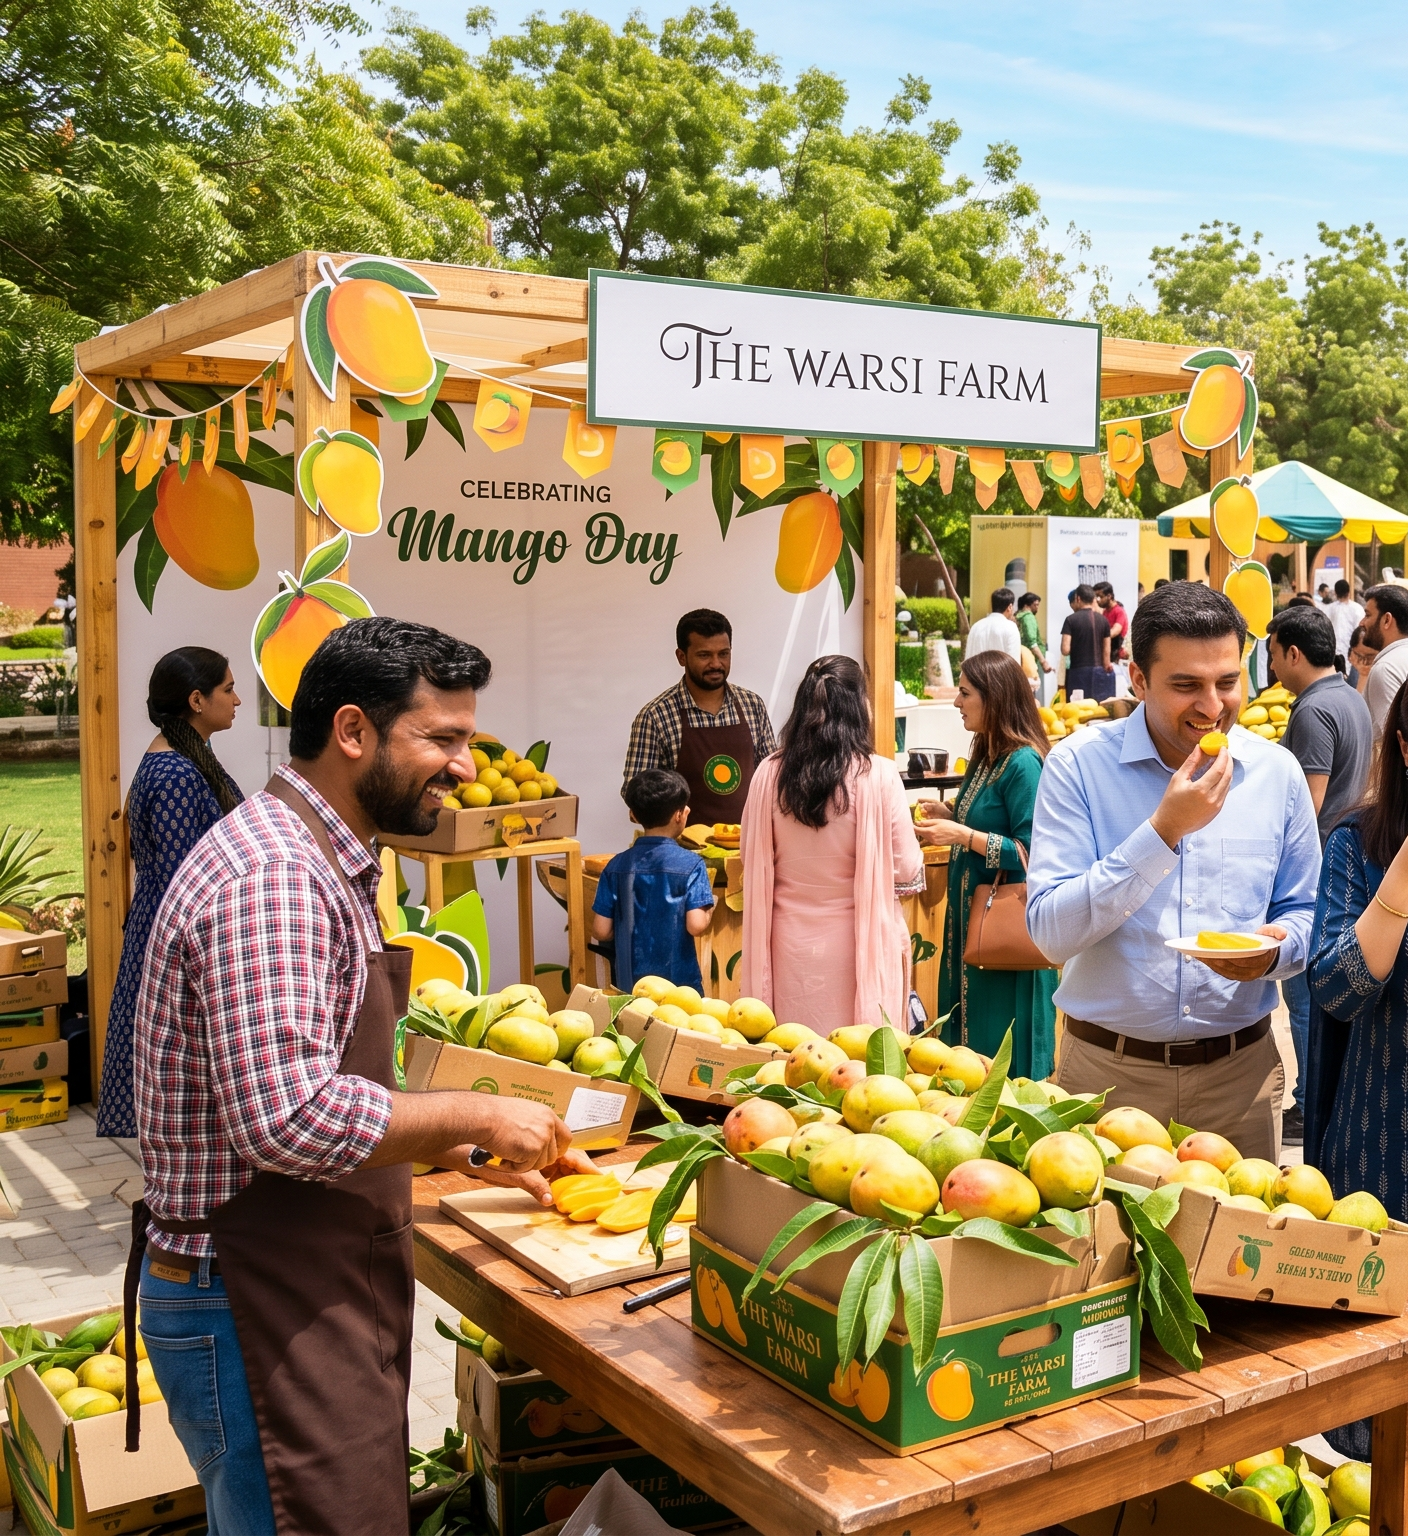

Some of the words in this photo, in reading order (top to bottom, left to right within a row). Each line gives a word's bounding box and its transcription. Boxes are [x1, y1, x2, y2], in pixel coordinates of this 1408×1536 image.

[784, 347, 923, 394] WARSI
[938, 360, 1050, 404] FARM
[460, 479, 611, 504] CELEBRATING
[387, 506, 573, 586] Mango
[585, 512, 683, 586] Day
[742, 1298, 769, 1329] THE
[772, 1311, 821, 1359] WARSI
[766, 1335, 808, 1379] FARM
[987, 1368, 1018, 1388] THE
[1021, 1354, 1066, 1377] WARSI
[1008, 1375, 1048, 1397] FARM
